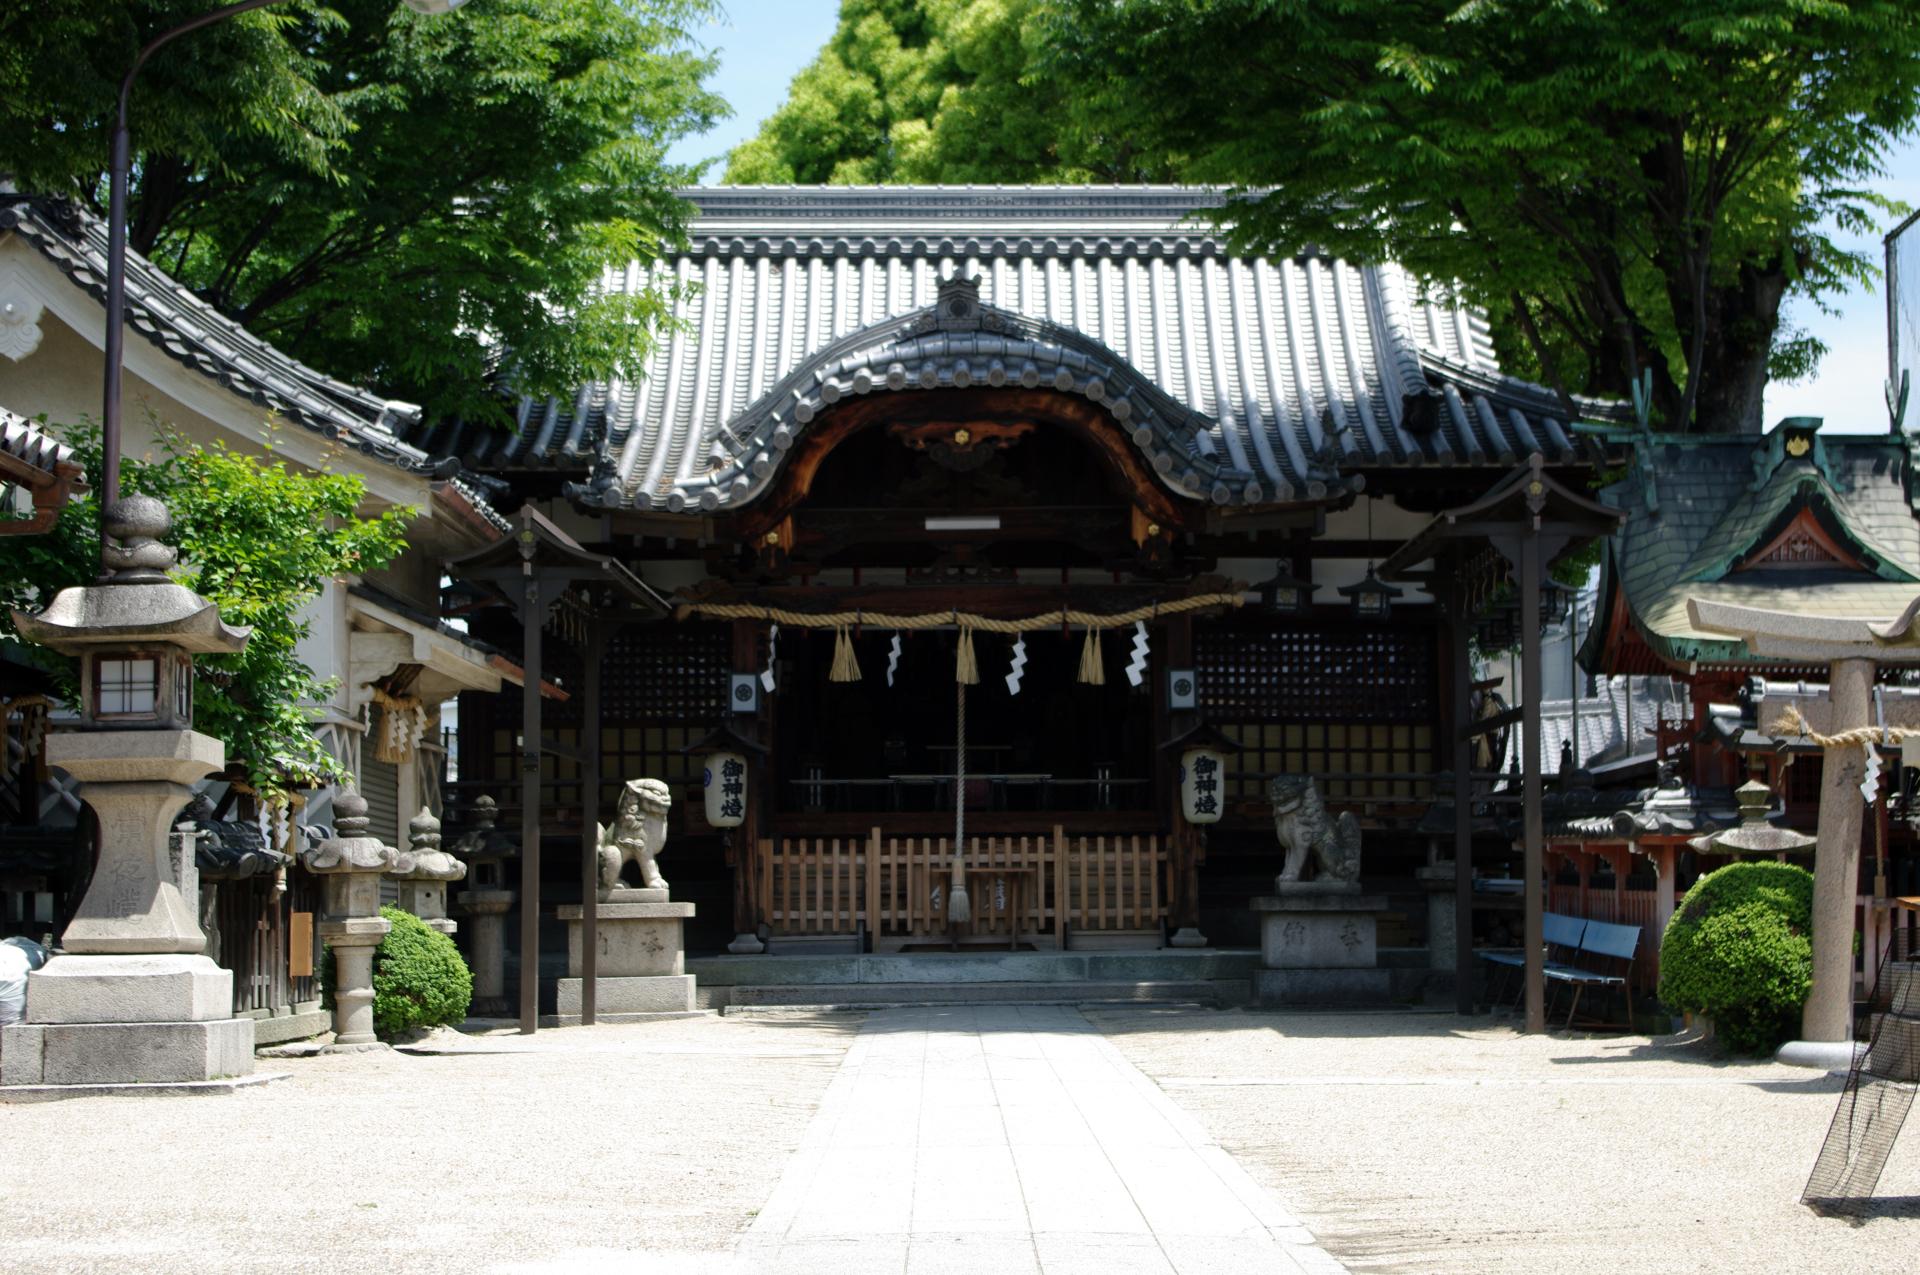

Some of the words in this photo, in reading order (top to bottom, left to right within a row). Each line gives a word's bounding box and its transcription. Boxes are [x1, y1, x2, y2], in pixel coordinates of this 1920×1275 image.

[721, 759, 744, 818] 御神燈
[1194, 756, 1217, 815] 御神燈
